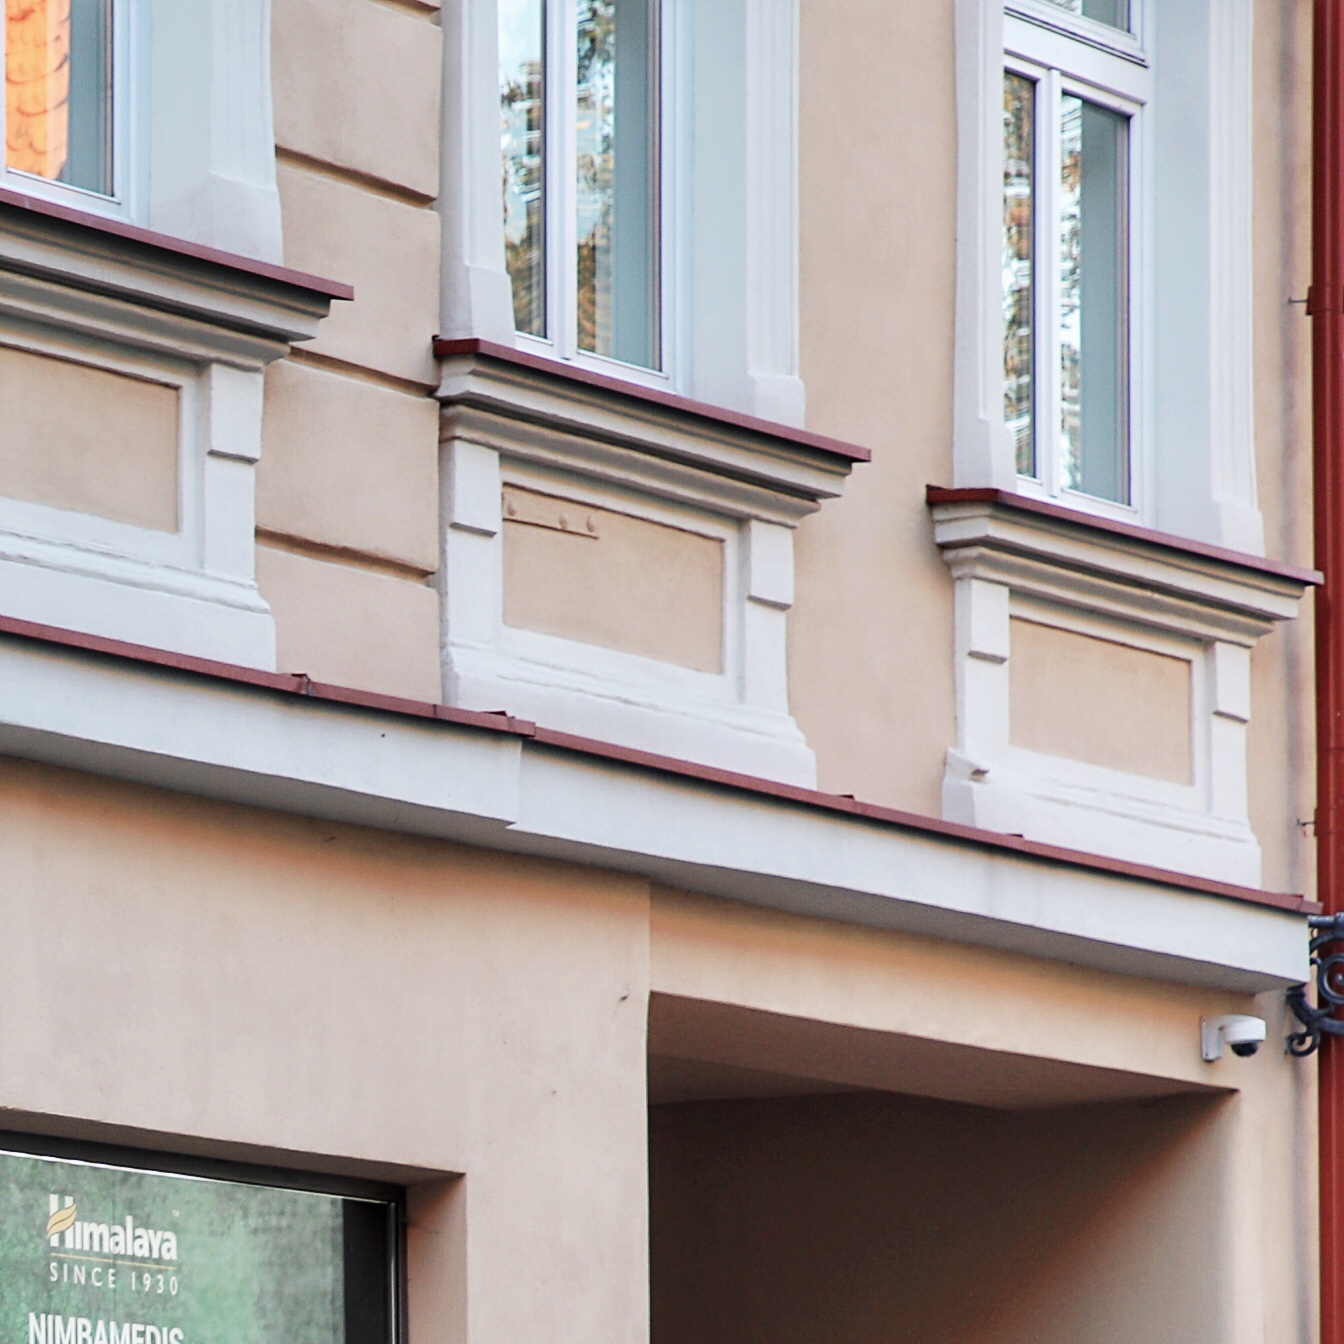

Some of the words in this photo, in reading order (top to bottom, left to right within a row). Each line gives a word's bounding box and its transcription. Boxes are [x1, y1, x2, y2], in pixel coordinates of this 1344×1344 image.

[47, 1193, 178, 1262] Himalaya
[49, 1261, 118, 1290] SINCE
[130, 1270, 179, 1297] 1930
